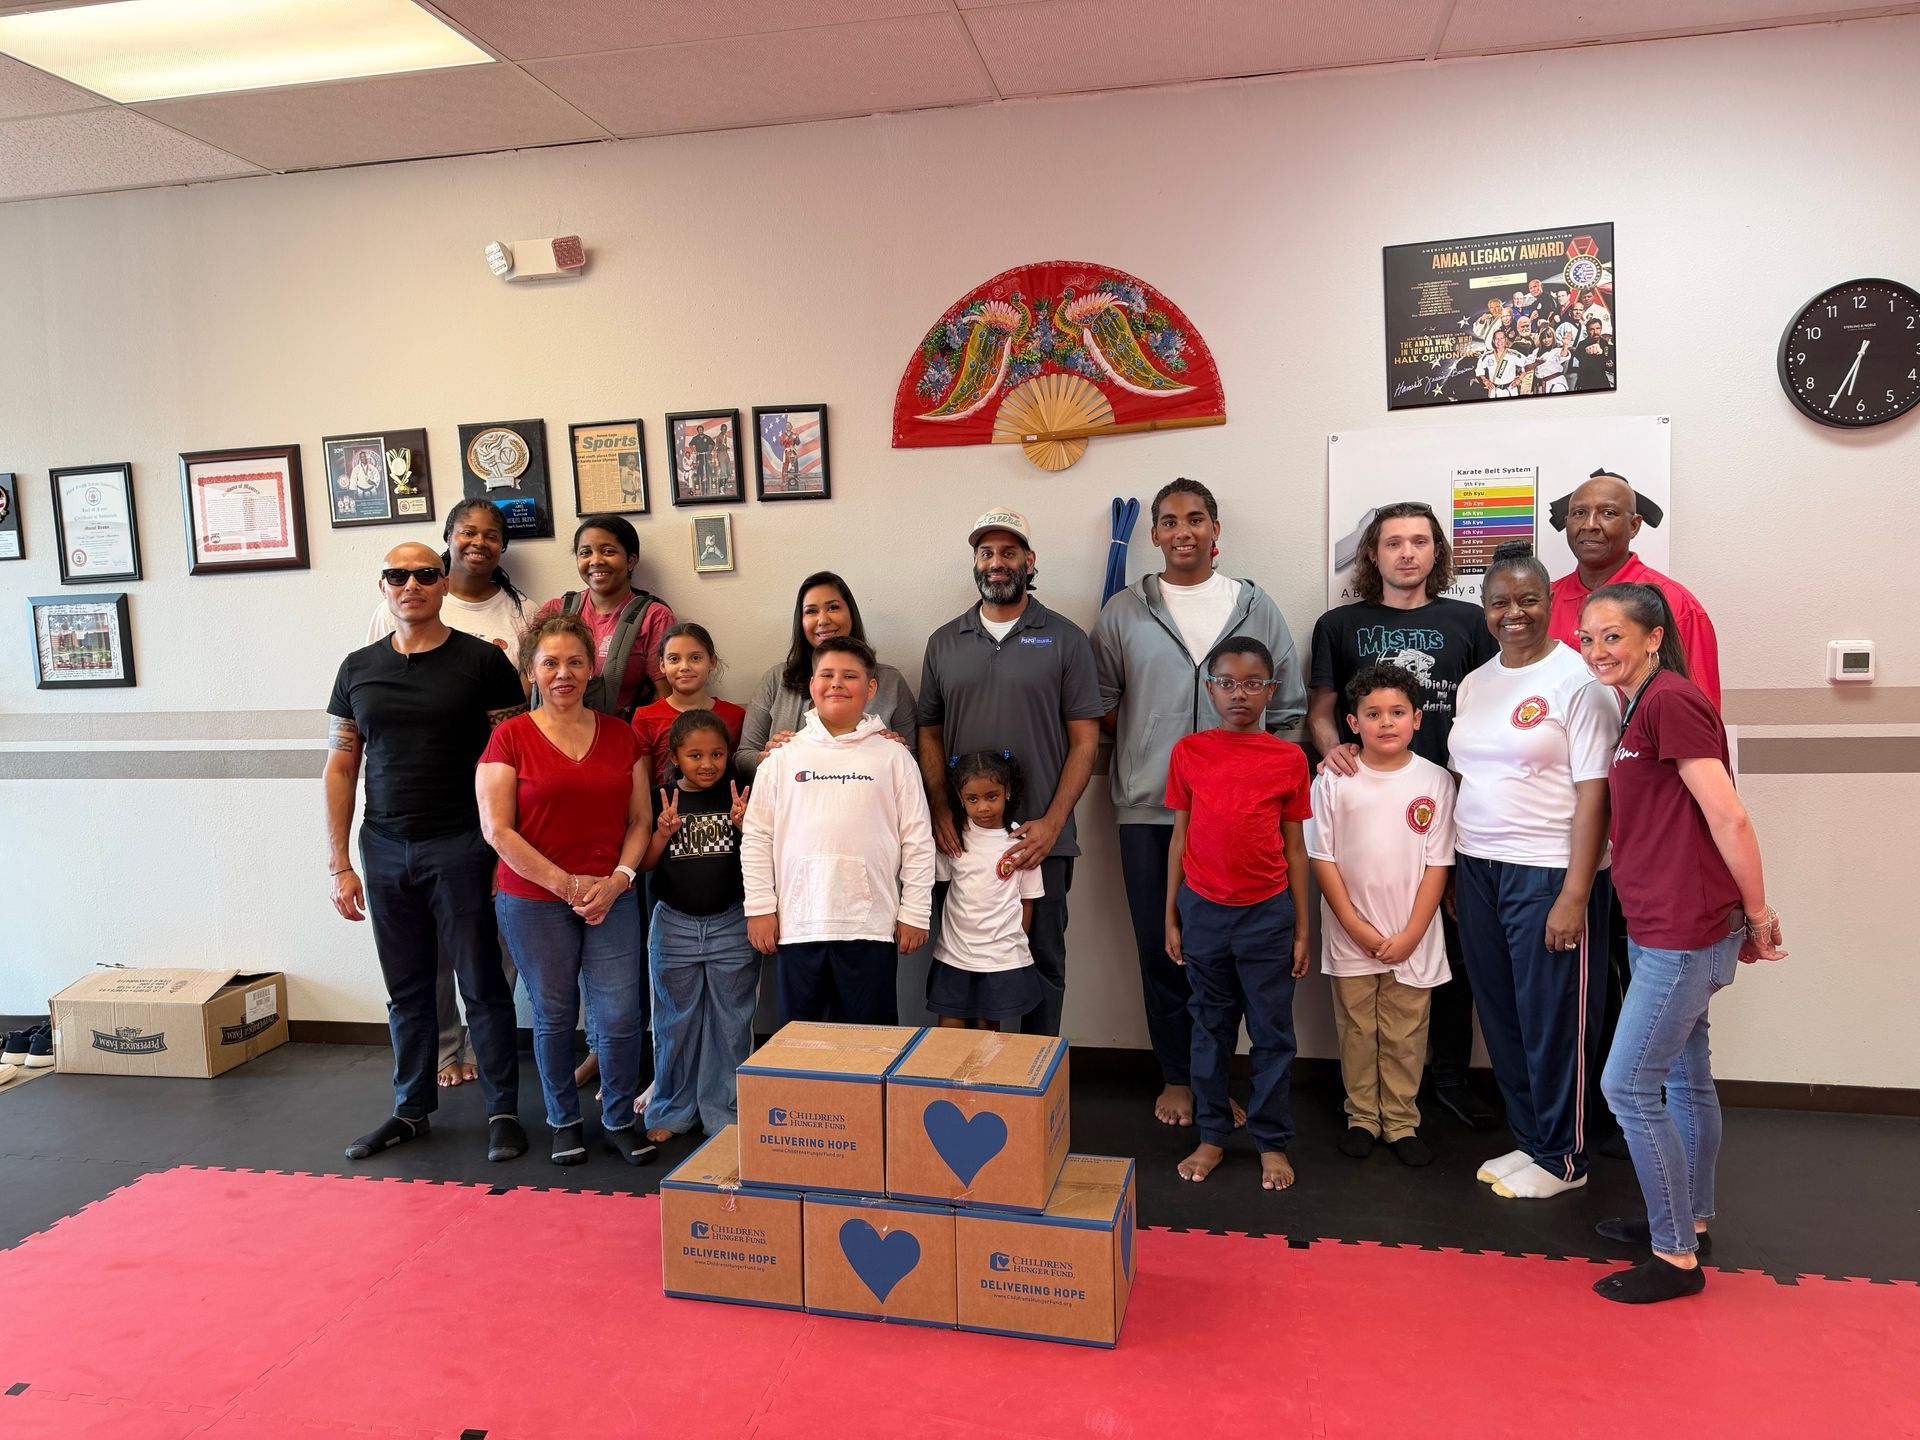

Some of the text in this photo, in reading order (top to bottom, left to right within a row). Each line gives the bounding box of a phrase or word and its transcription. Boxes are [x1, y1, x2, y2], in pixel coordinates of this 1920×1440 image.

[1432, 241, 1565, 269] AMAA LEGACY AWARD
[1853, 295, 1867, 309] 12
[1888, 300, 1894, 312] 1
[1826, 305, 1838, 318] 11
[1906, 316, 1915, 329] 2
[1805, 327, 1821, 340] 10
[1394, 355, 1419, 364] HALL
[1797, 353, 1806, 365] 9
[1907, 368, 1917, 380] 4
[1806, 376, 1814, 389] 8
[1885, 389, 1894, 402] 5
[1856, 399, 1865, 412] 6
[582, 435, 637, 452] Sports
[1341, 588, 1349, 598] A
[1468, 586, 1475, 594] a
[1357, 625, 1444, 656] MISFITS
[795, 770, 874, 785] Champion
[99, 1037, 160, 1051] PEPPERIDGE FARM
[789, 1110, 845, 1122] CHILDREN'S
[790, 1120, 824, 1129] HUNGER
[760, 1134, 857, 1151] DELIVERING HOPE
[711, 1224, 766, 1237] CHILDREN'S
[712, 1233, 744, 1243] HUNGER
[682, 1246, 777, 1265] DELIVERING HOPE
[1012, 1255, 1073, 1270] CHILDREN'S
[1013, 1265, 1050, 1276] HUNGER
[980, 1279, 1086, 1300] DELIVERING HOPE
